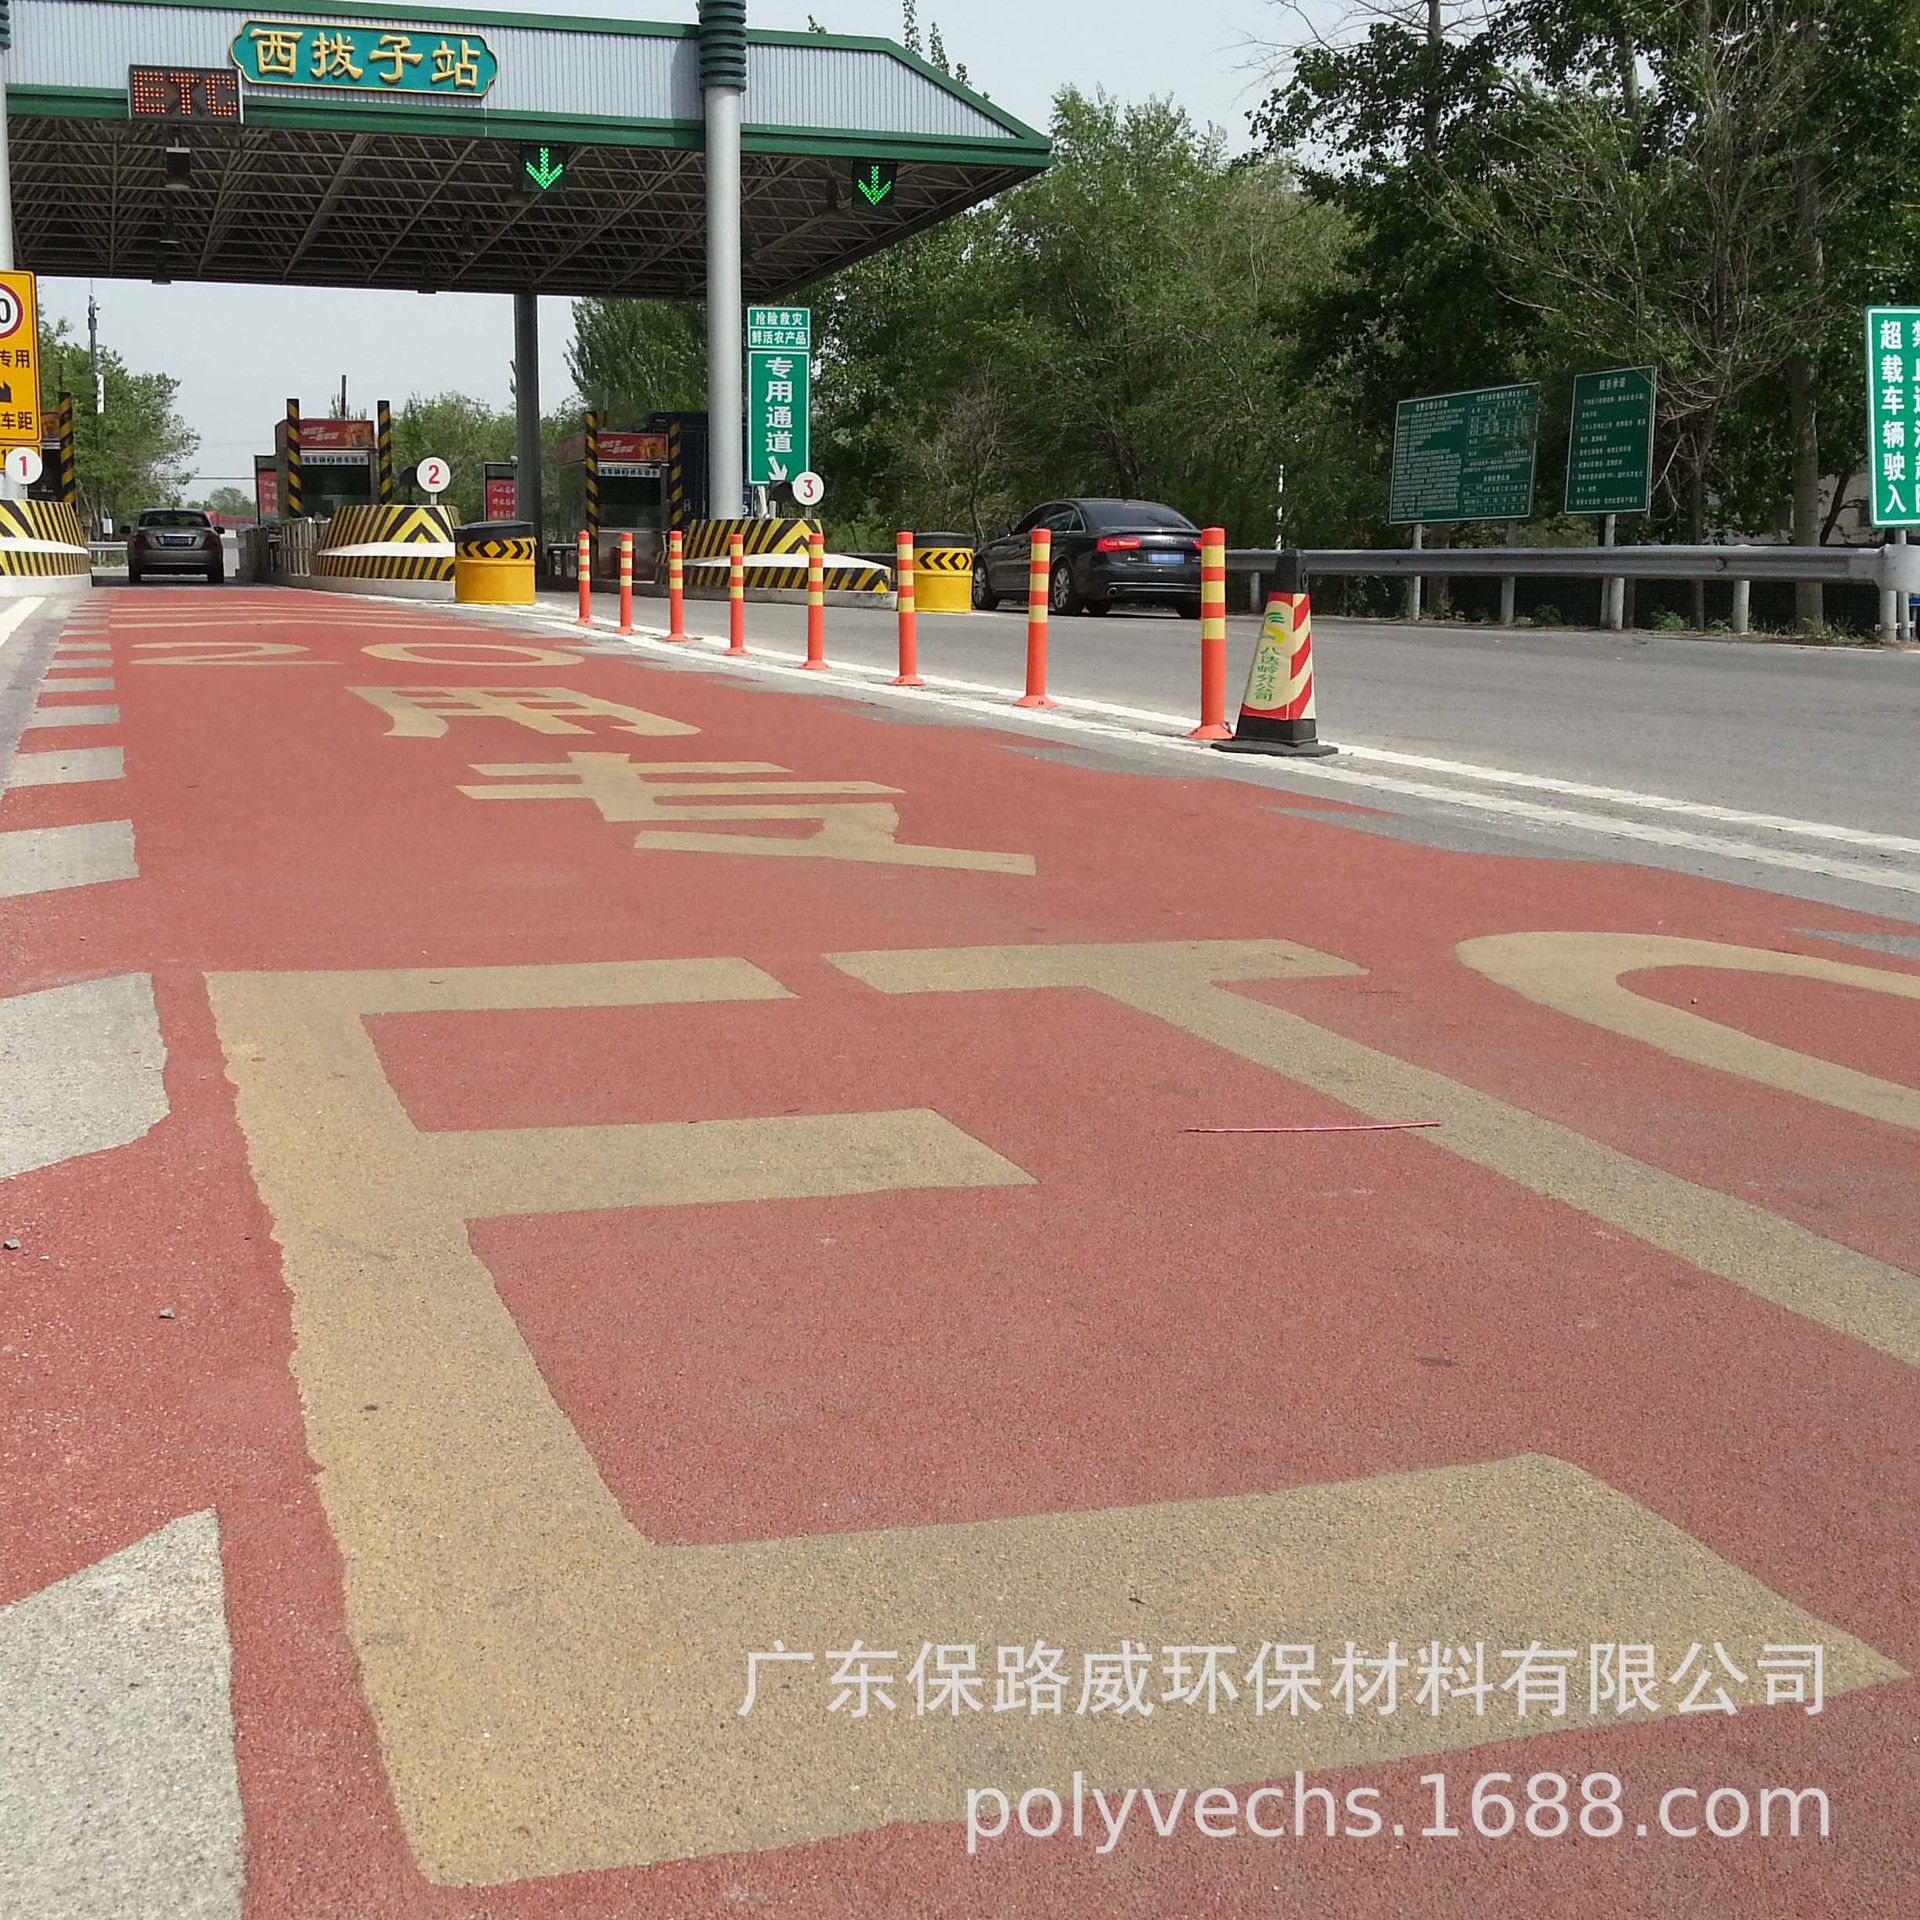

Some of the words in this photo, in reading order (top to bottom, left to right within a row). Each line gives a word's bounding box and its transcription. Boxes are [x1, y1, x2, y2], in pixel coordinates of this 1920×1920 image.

[250, 28, 480, 90] 西拨子站
[134, 71, 237, 117] ETC
[755, 311, 803, 326] 抢险救灾
[752, 330, 806, 345] 鲜活农产品
[0, 349, 30, 368] 专用
[765, 356, 794, 453] 专用通道
[1, 411, 33, 430] 车距
[1880, 320, 1907, 513] 超载车辆驶入
[19, 456, 27, 477] 1
[428, 464, 440, 485] 2
[803, 479, 814, 499] 3
